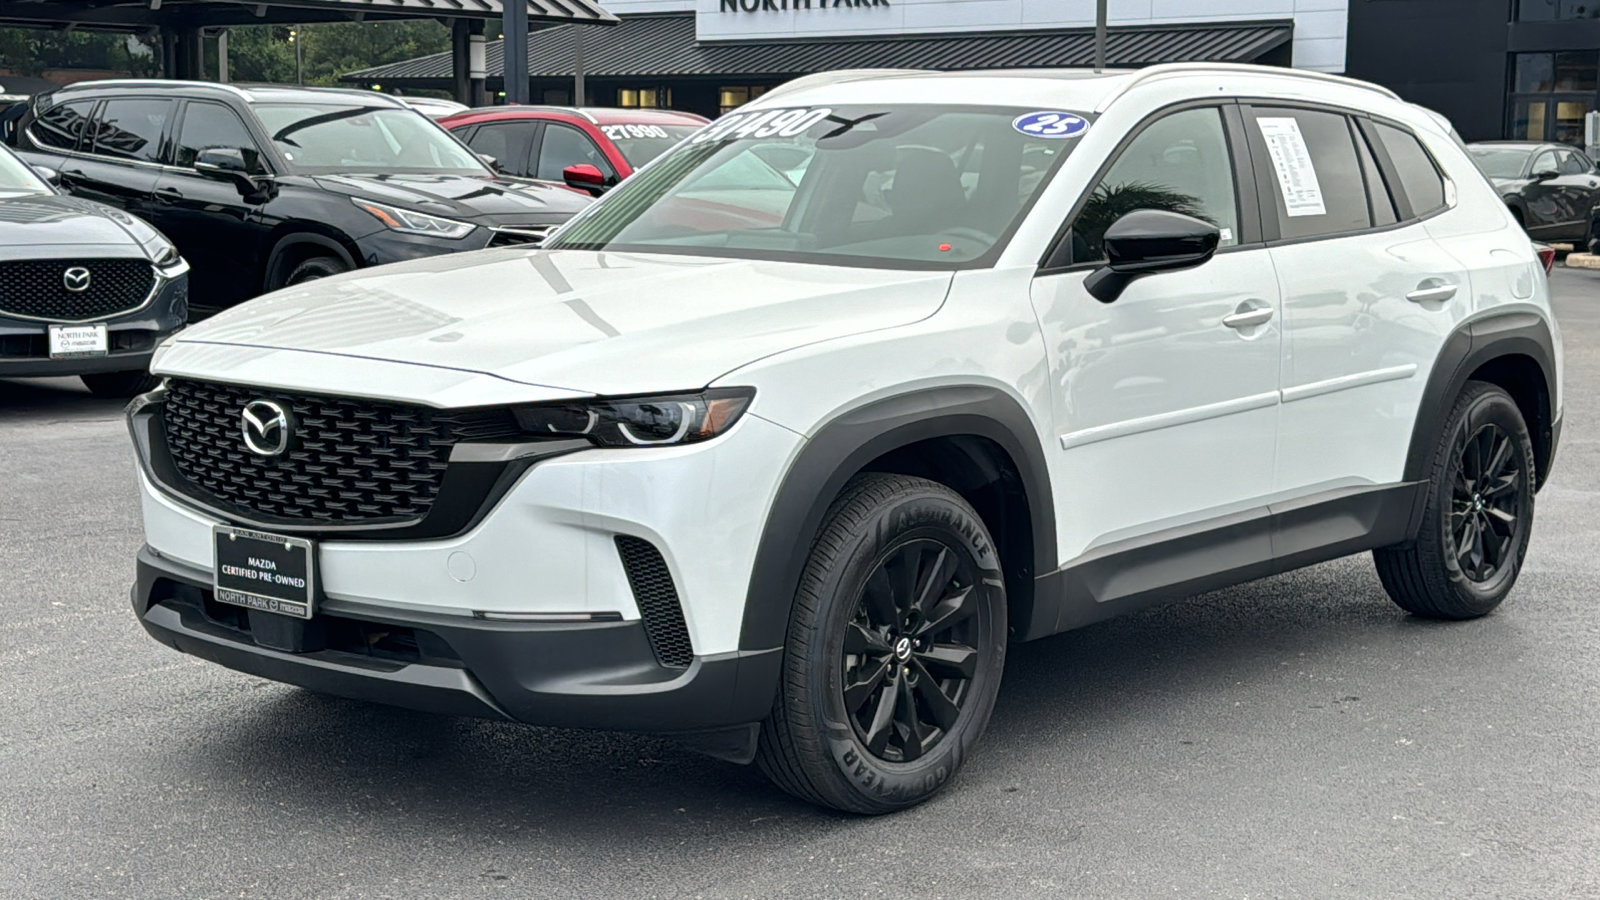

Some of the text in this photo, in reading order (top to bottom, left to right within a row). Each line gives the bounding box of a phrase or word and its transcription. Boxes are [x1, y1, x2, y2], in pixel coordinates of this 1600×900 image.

[692, 107, 832, 143] 31490
[1023, 114, 1080, 134] 25
[57, 332, 81, 340] NORTH
[248, 556, 277, 570] MAZDA
[221, 564, 305, 588] CERTIFIED PRE-OWNED
[219, 590, 305, 615] NORTH PARK mazda
